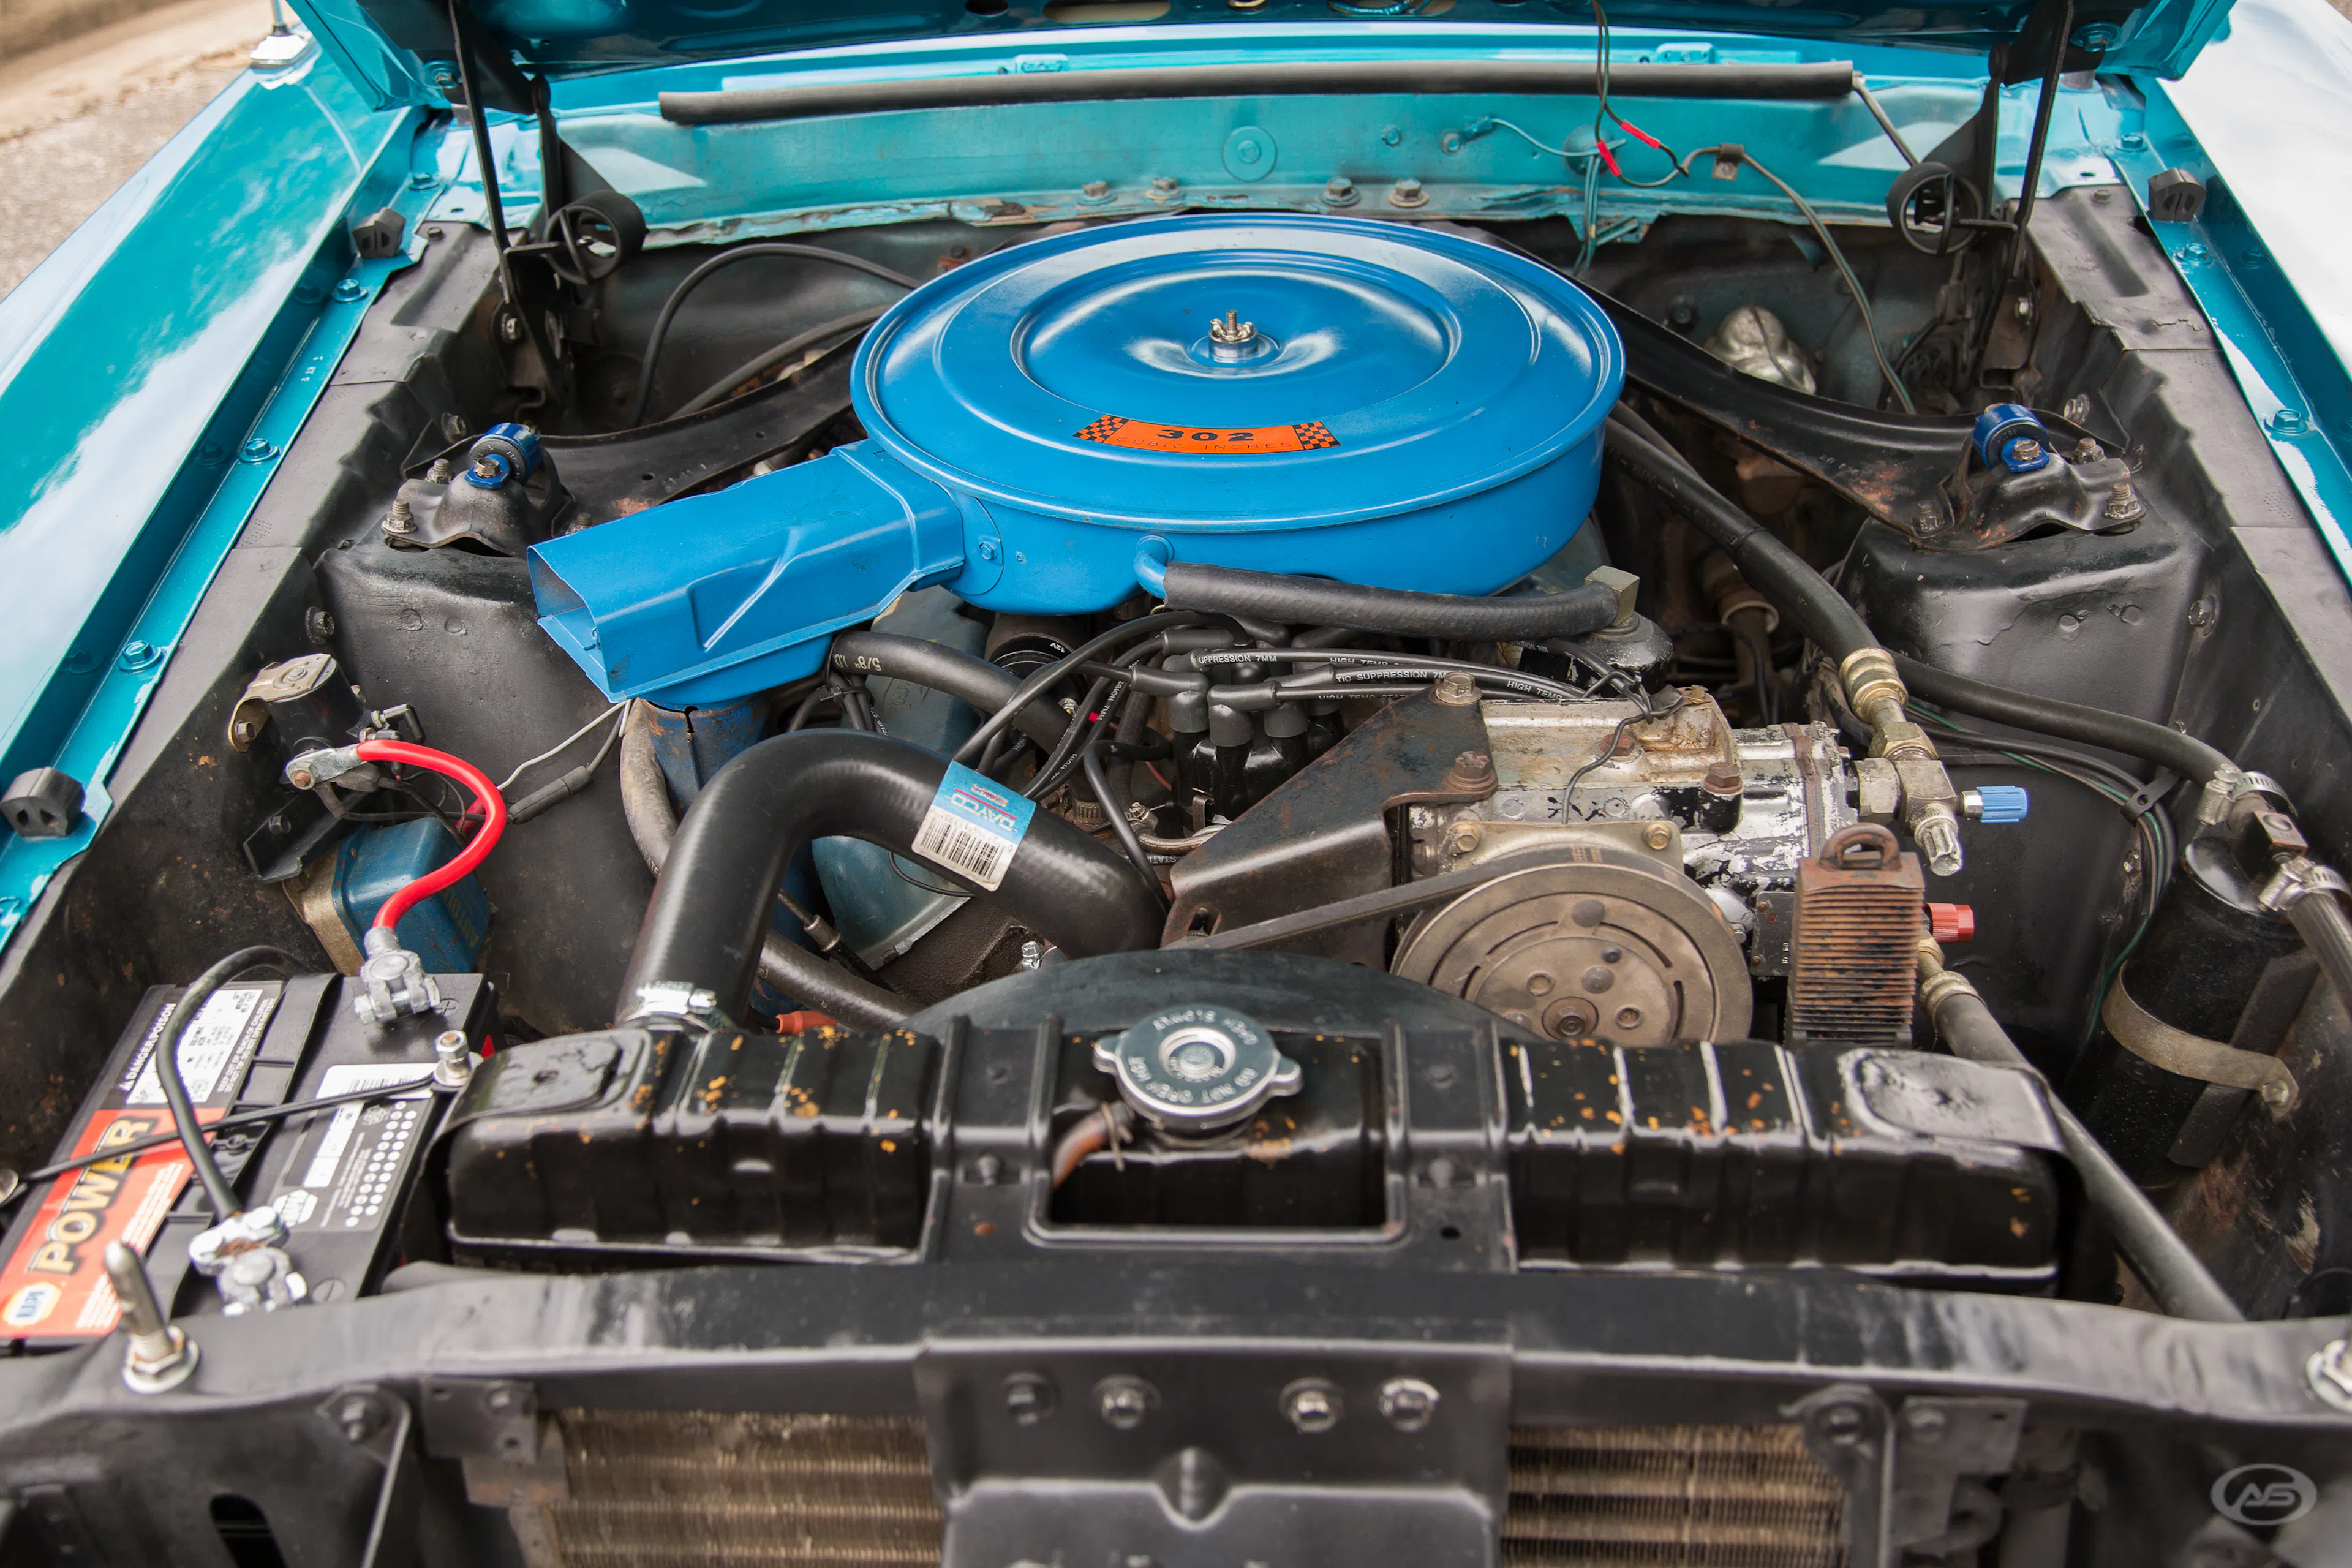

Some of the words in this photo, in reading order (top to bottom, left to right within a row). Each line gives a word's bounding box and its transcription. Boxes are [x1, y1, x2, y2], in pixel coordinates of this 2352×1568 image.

[1117, 437, 1184, 449] CUBIC
[1157, 429, 1254, 442] 302
[1050, 643, 1066, 653] 12V
[854, 655, 882, 672] 5/8"
[1336, 676, 1352, 684] TIC
[1357, 671, 1428, 681] SUPPRESSION
[1507, 680, 1532, 692] HIGH
[1536, 688, 1562, 701] TEMP
[951, 793, 1016, 832] DAYCO
[125, 1003, 177, 1081] DANGER/POISON
[1201, 1082, 1237, 1104] NOT
[29, 1117, 157, 1275] POWER
